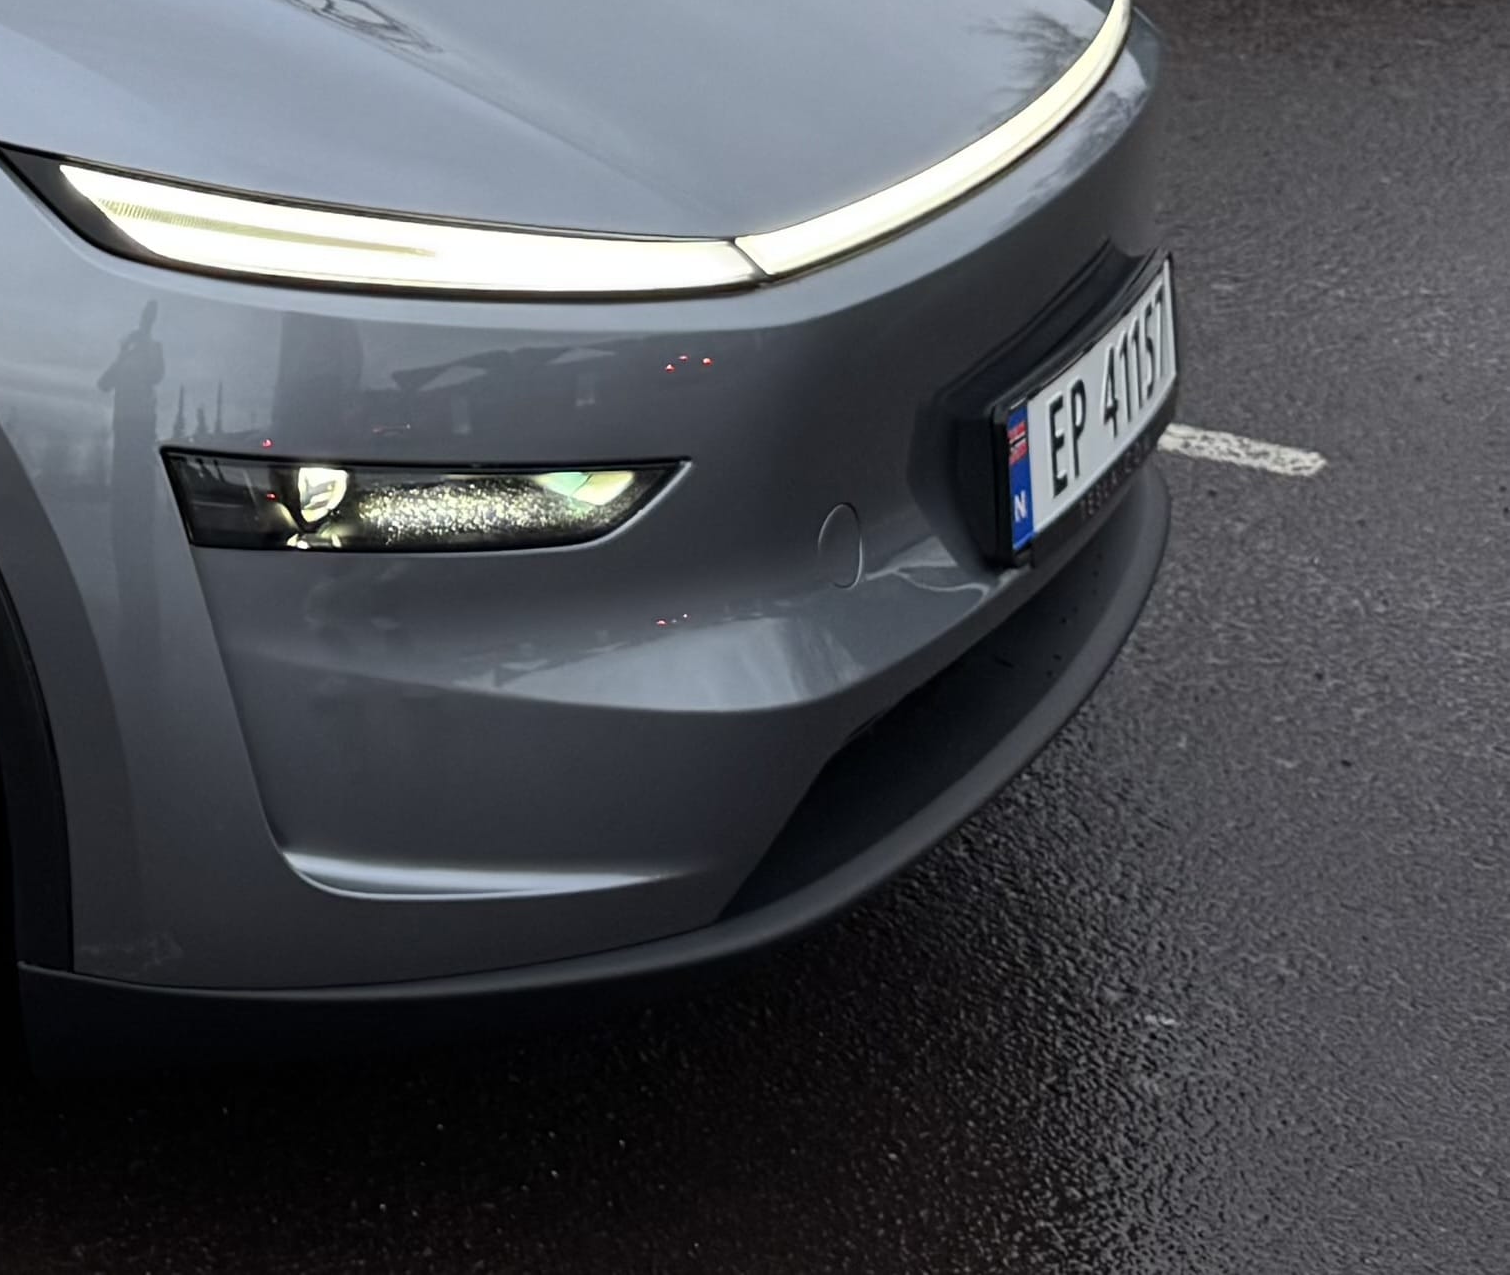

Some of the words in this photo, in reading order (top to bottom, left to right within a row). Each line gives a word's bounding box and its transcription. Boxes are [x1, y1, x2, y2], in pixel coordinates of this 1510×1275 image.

[1048, 379, 1087, 499] EP
[1102, 283, 1165, 439] 41157
[1014, 490, 1027, 523] N
